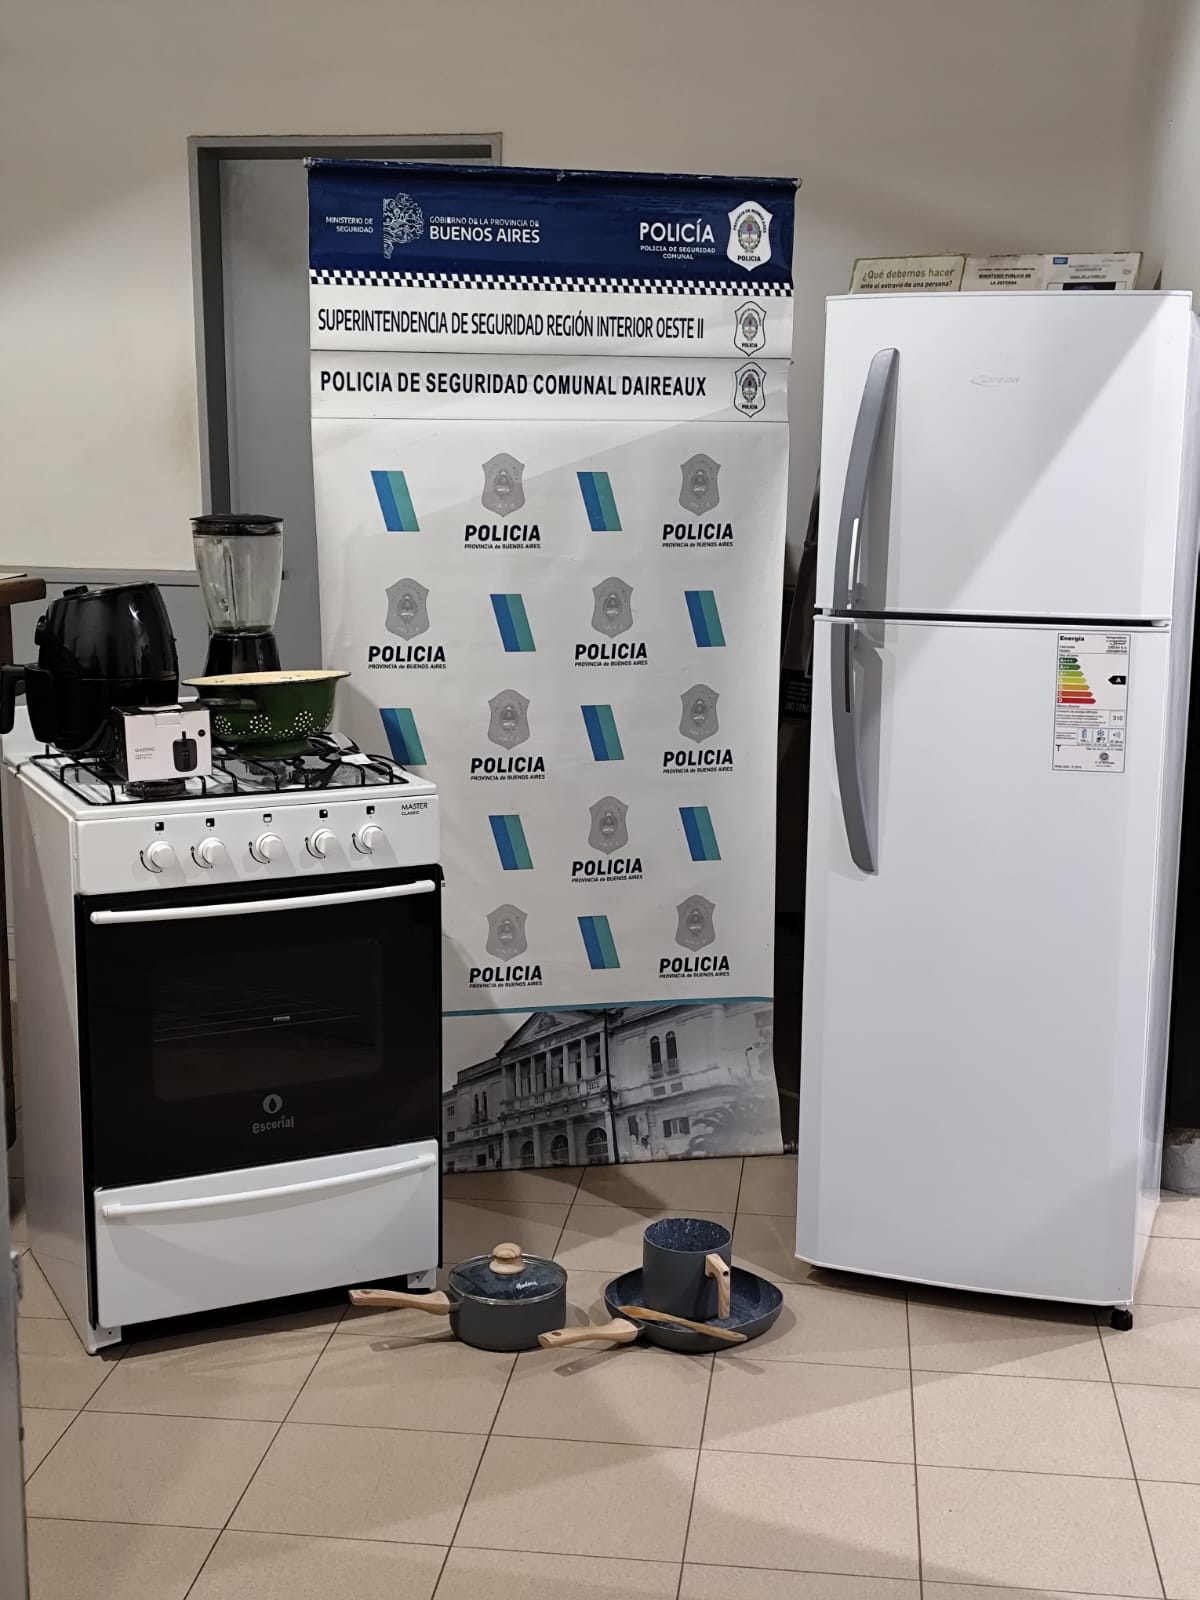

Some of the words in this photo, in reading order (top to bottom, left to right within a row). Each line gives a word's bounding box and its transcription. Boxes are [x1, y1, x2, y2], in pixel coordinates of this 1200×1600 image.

[326, 216, 363, 224] MINISTERIO
[430, 216, 466, 224] GOBIERNO
[490, 218, 527, 226] PROVINCIA
[430, 226, 492, 241] BUENOS
[496, 228, 540, 243] AIRES
[640, 218, 715, 243] POLICÍA
[862, 269, 884, 281] ¿Qué
[886, 269, 926, 279] debemos
[928, 268, 955, 277] hacer
[318, 309, 448, 333] SUPERINTENDENCIA
[452, 312, 468, 334] DE
[472, 313, 543, 336] SEGURIDAD
[547, 310, 593, 336] REGIÓN
[597, 316, 653, 338] INTERIOR
[656, 317, 694, 338] OESTE
[698, 318, 704, 338] II
[321, 371, 392, 392] POLICIA
[398, 372, 420, 392] DE
[426, 373, 527, 394] SEGURIDAD
[534, 375, 616, 395] COMUNAL
[622, 376, 706, 396] DAIREAUX
[465, 525, 540, 541] POLICIA
[663, 523, 733, 540] POLICIA
[368, 646, 446, 662] POLICIA
[575, 643, 647, 660] POLICIA
[471, 757, 545, 773] POLICIA
[663, 749, 733, 767] POLICIA
[572, 858, 642, 876] POLICIA
[660, 956, 729, 973] POLICIA
[470, 965, 542, 983] POLICIA
[252, 1115, 294, 1134] escorial
